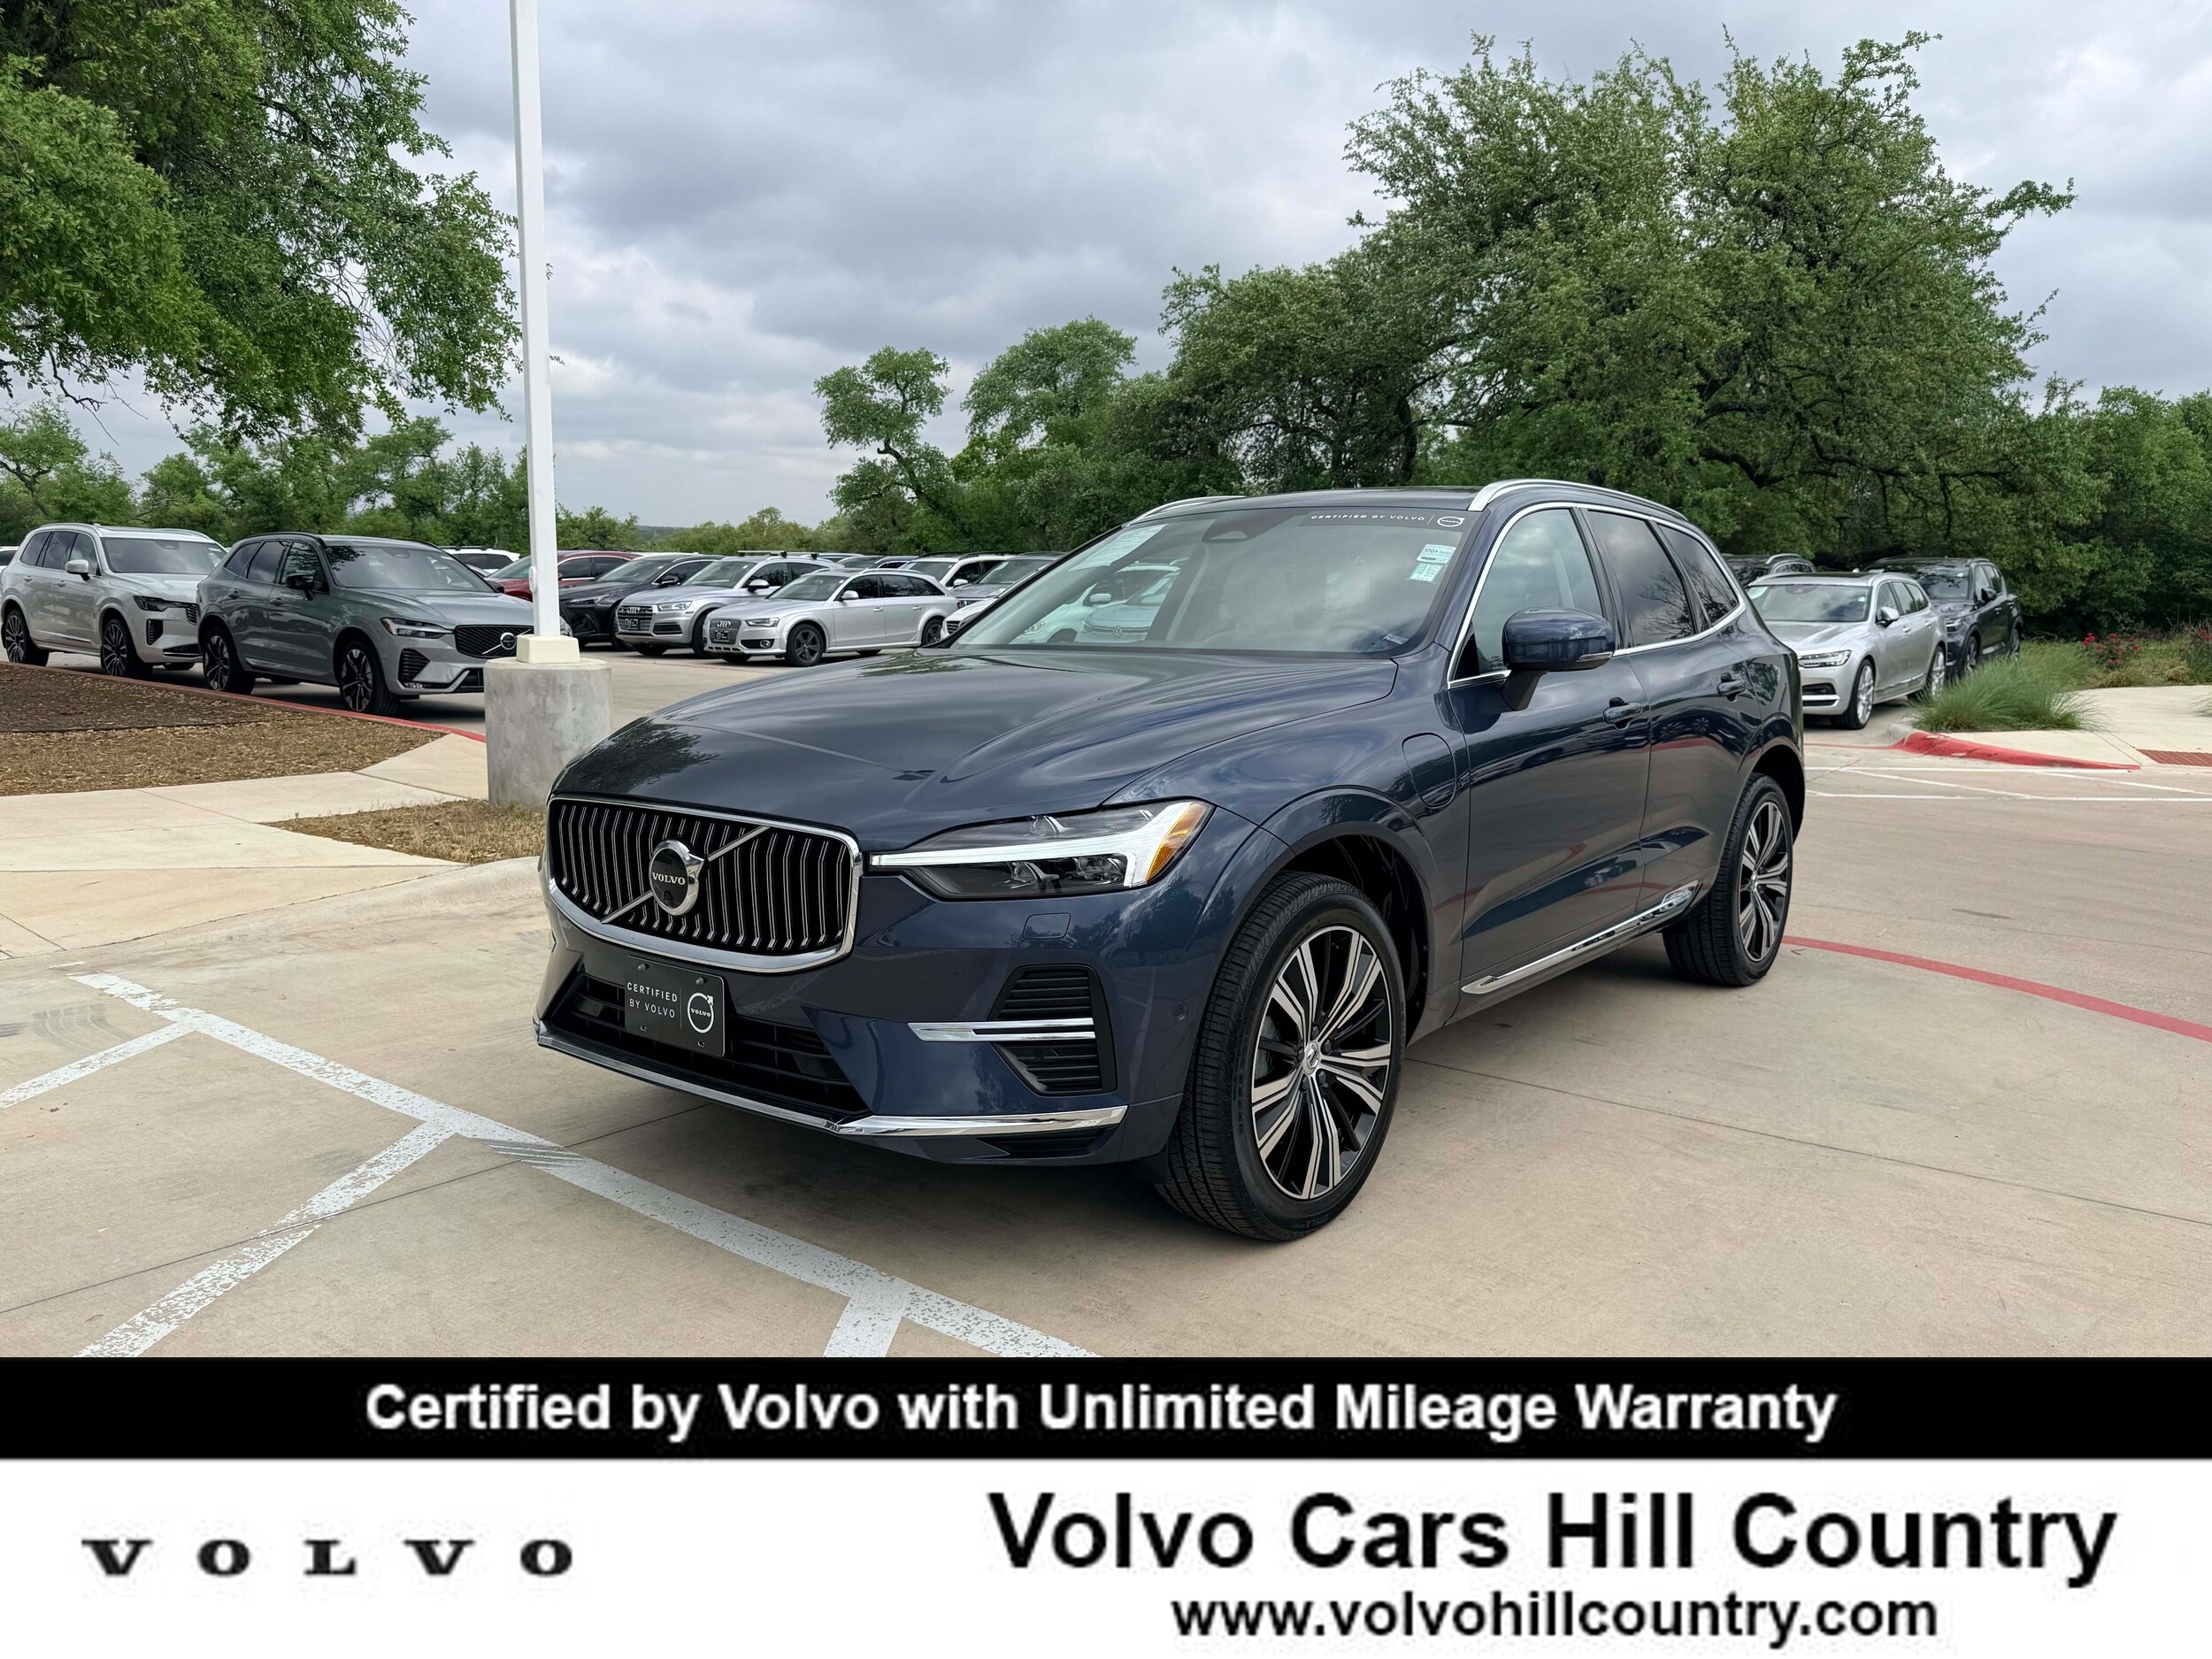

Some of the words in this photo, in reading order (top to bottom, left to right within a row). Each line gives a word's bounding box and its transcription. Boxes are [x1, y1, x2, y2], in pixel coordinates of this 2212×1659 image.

[651, 872, 686, 886] VOLVO
[626, 981, 678, 1002] CERTIFIED
[629, 998, 641, 1009] BY
[644, 1002, 675, 1018] VOLVO
[690, 1008, 711, 1018] VOLVO
